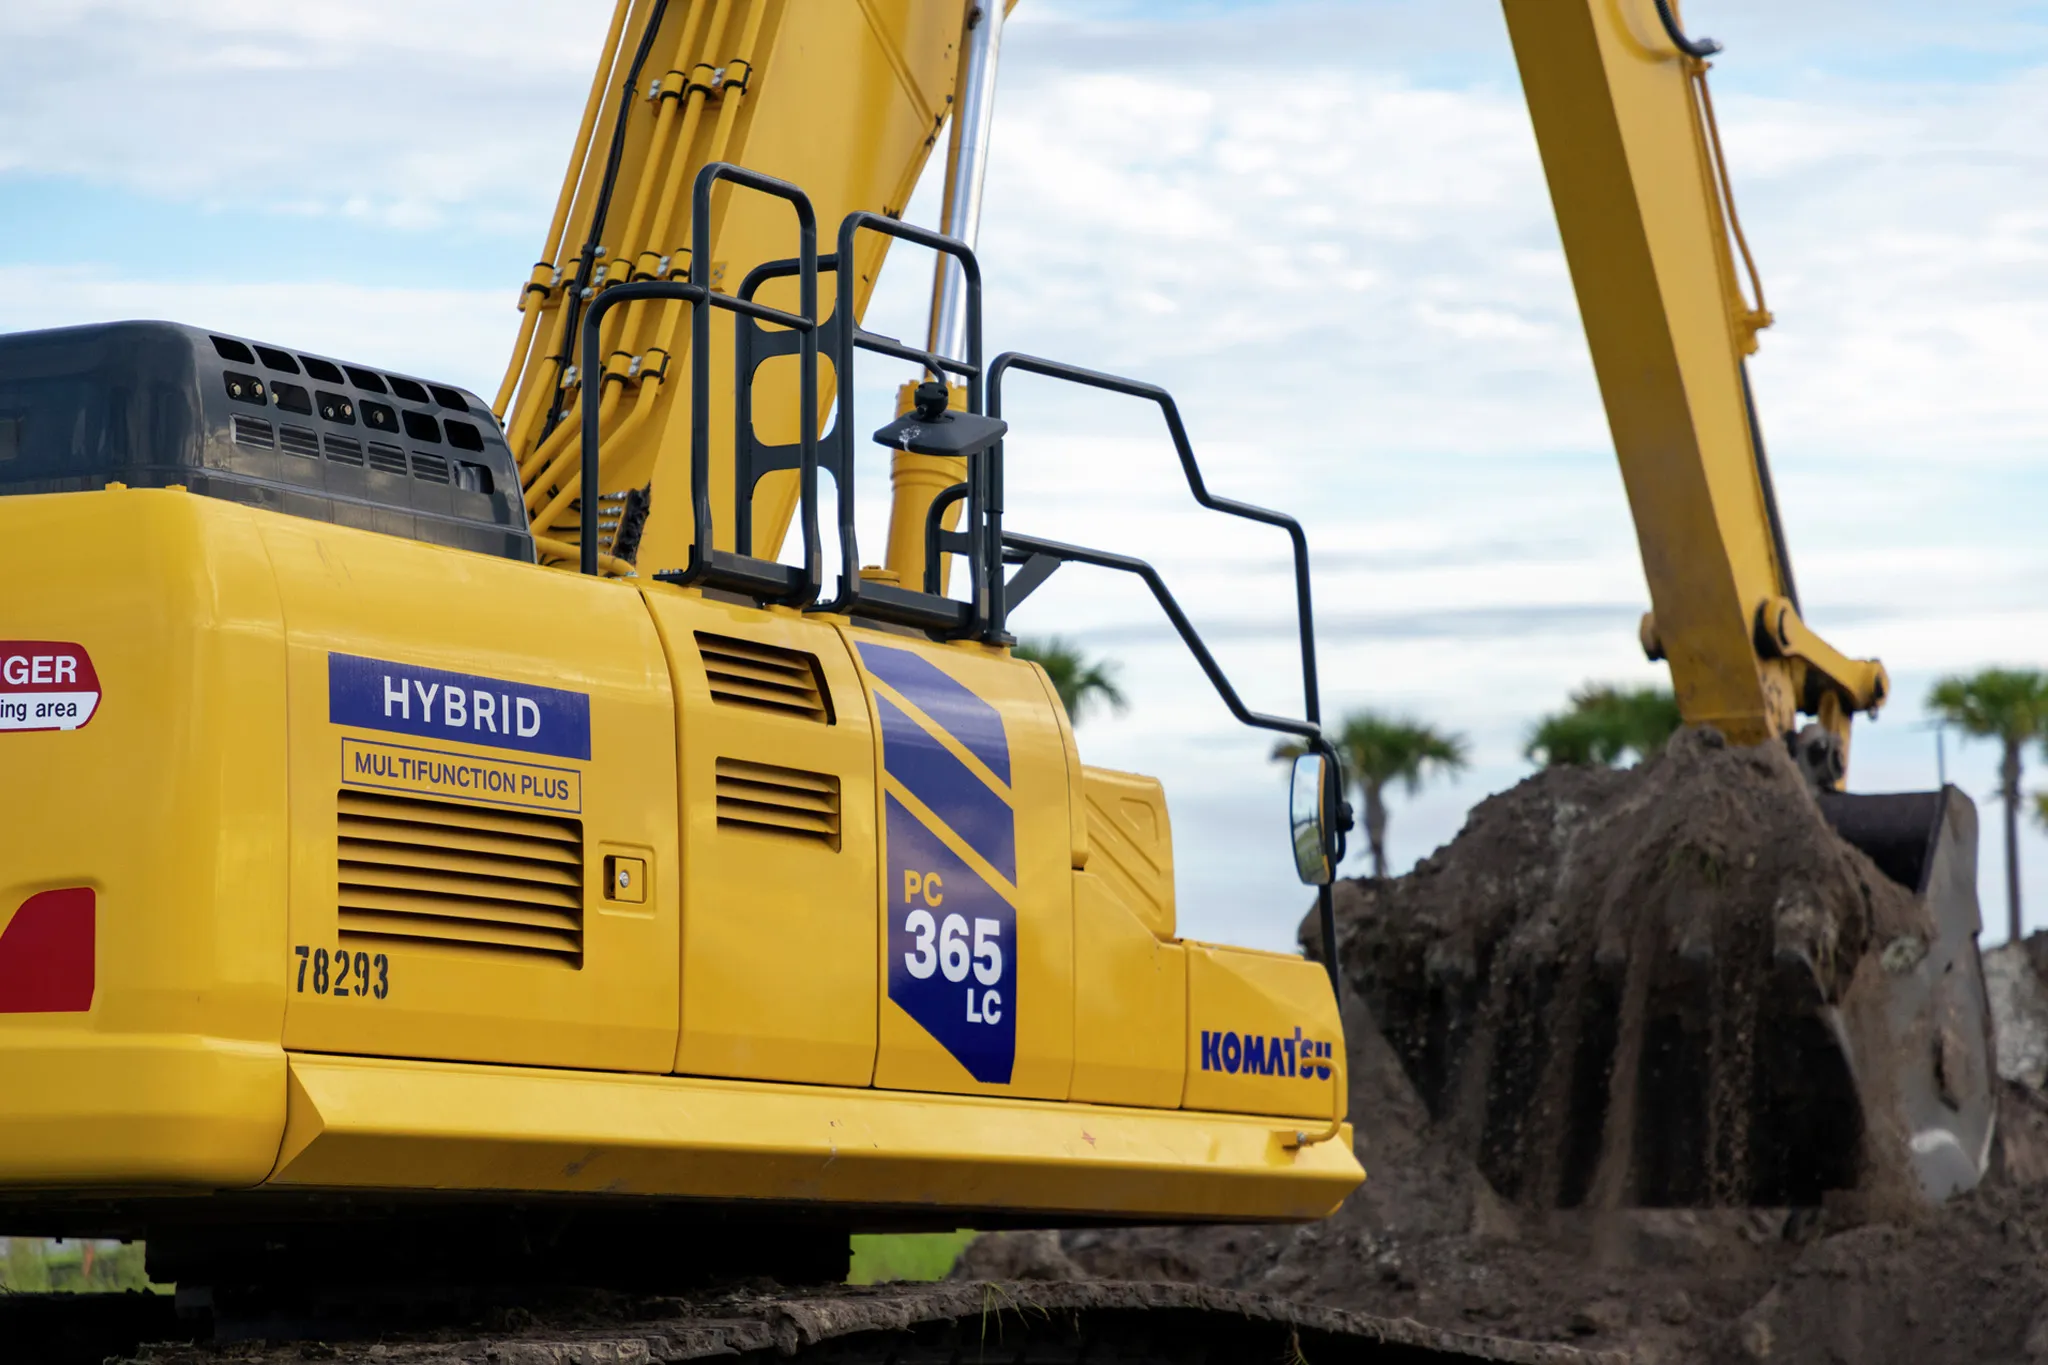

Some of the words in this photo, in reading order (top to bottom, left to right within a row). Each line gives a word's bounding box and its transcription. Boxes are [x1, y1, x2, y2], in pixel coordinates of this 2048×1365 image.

[0, 655, 78, 686] GER
[35, 702, 77, 718] area
[383, 675, 541, 738] HYBRID
[355, 751, 516, 794] MULTIFUNCTION
[521, 774, 569, 801] PLUS
[904, 869, 944, 907] PC
[295, 945, 389, 1000] 78293
[904, 909, 1003, 987] 365
[966, 988, 1002, 1026] LC
[1201, 1026, 1332, 1082] KOMATSU
